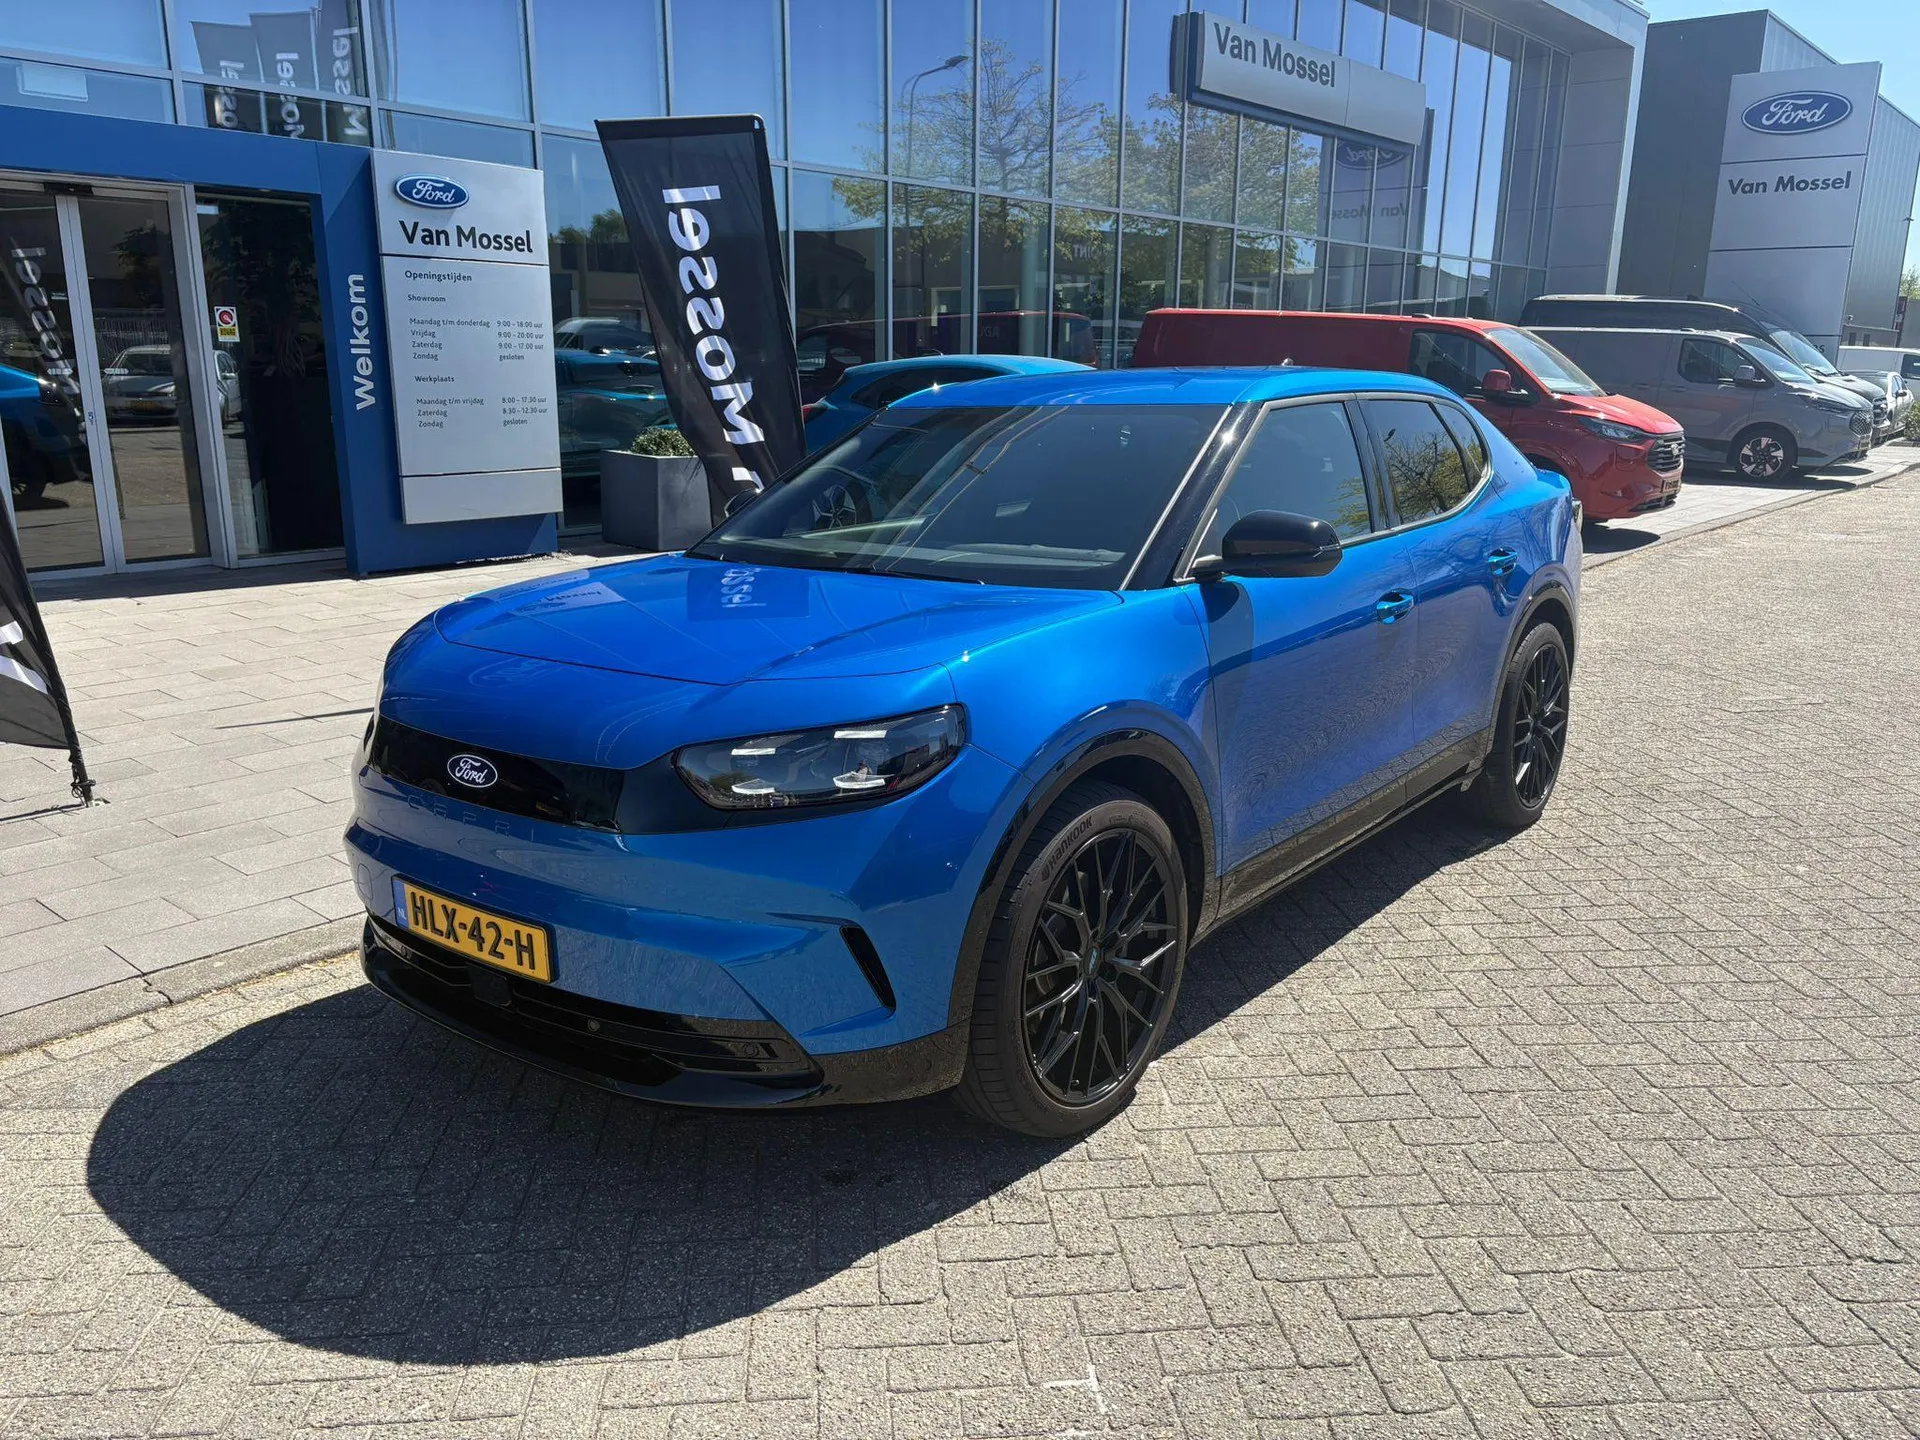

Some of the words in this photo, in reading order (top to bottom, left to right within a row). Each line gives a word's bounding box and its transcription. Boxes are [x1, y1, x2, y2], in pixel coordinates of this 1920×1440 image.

[1213, 22, 1256, 64] Van
[1262, 38, 1335, 88] Mossel
[1761, 98, 1830, 126] Ford
[1728, 177, 1768, 195] Van
[1774, 170, 1852, 193] Mossel
[412, 180, 456, 203] Ford
[398, 220, 450, 247] Van
[456, 225, 534, 253] Mossel
[405, 270, 472, 283] Openingstijden
[407, 293, 447, 302] Showroom
[409, 317, 441, 327] Maandag
[456, 319, 490, 328] donderdag
[410, 329, 436, 338] Vrijdag
[348, 273, 375, 411] Welkom
[411, 340, 442, 350] Zaterdag
[413, 352, 439, 361] Zondag
[499, 353, 525, 362] gesloten
[414, 375, 455, 384] Werkplaats
[416, 398, 447, 406] Maandag
[462, 397, 484, 406] vrijdag
[417, 409, 448, 418] Zaterdag
[418, 420, 444, 429] Zondag
[502, 417, 528, 427] gesloten
[455, 758, 488, 784] Ford
[397, 906, 408, 920] NL
[410, 891, 536, 970] HLX-42-H
